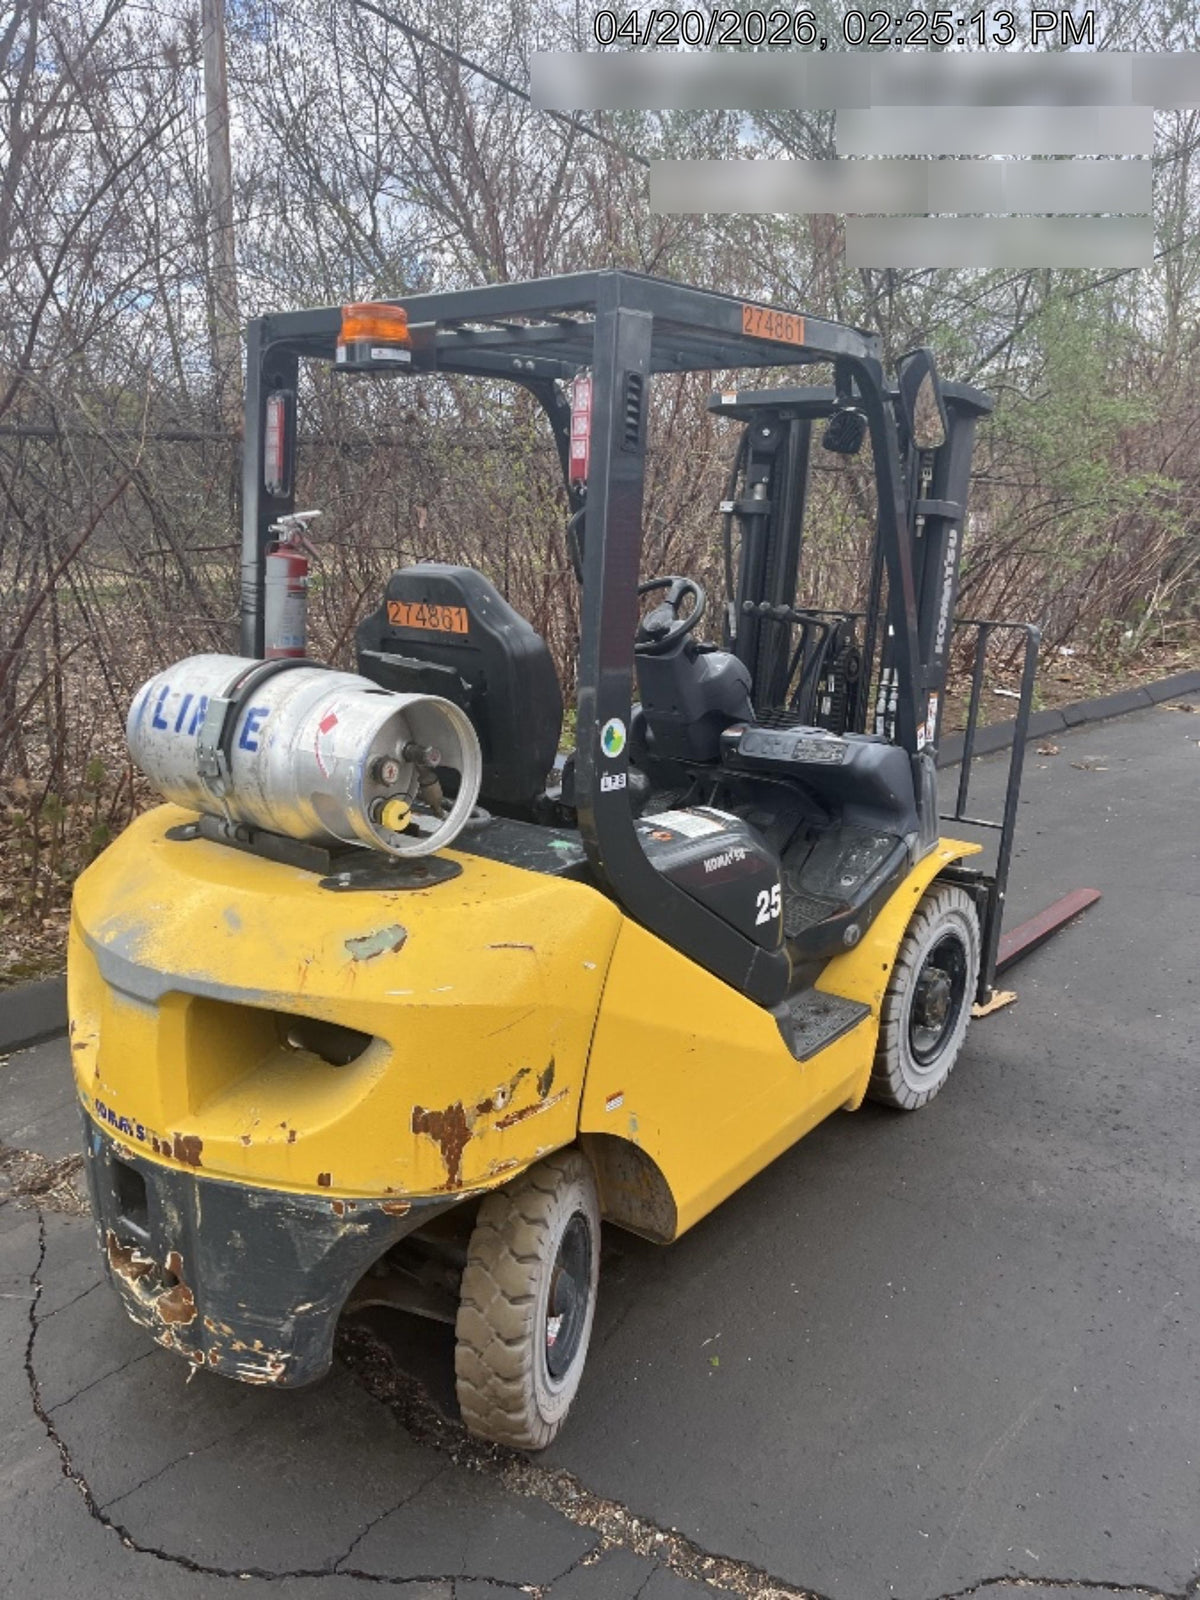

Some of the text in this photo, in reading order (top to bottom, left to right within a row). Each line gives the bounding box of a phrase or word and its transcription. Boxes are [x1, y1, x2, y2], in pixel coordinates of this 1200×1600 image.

[744, 306, 802, 342] 274861
[388, 602, 464, 632] 274861
[755, 883, 782, 926] 25
